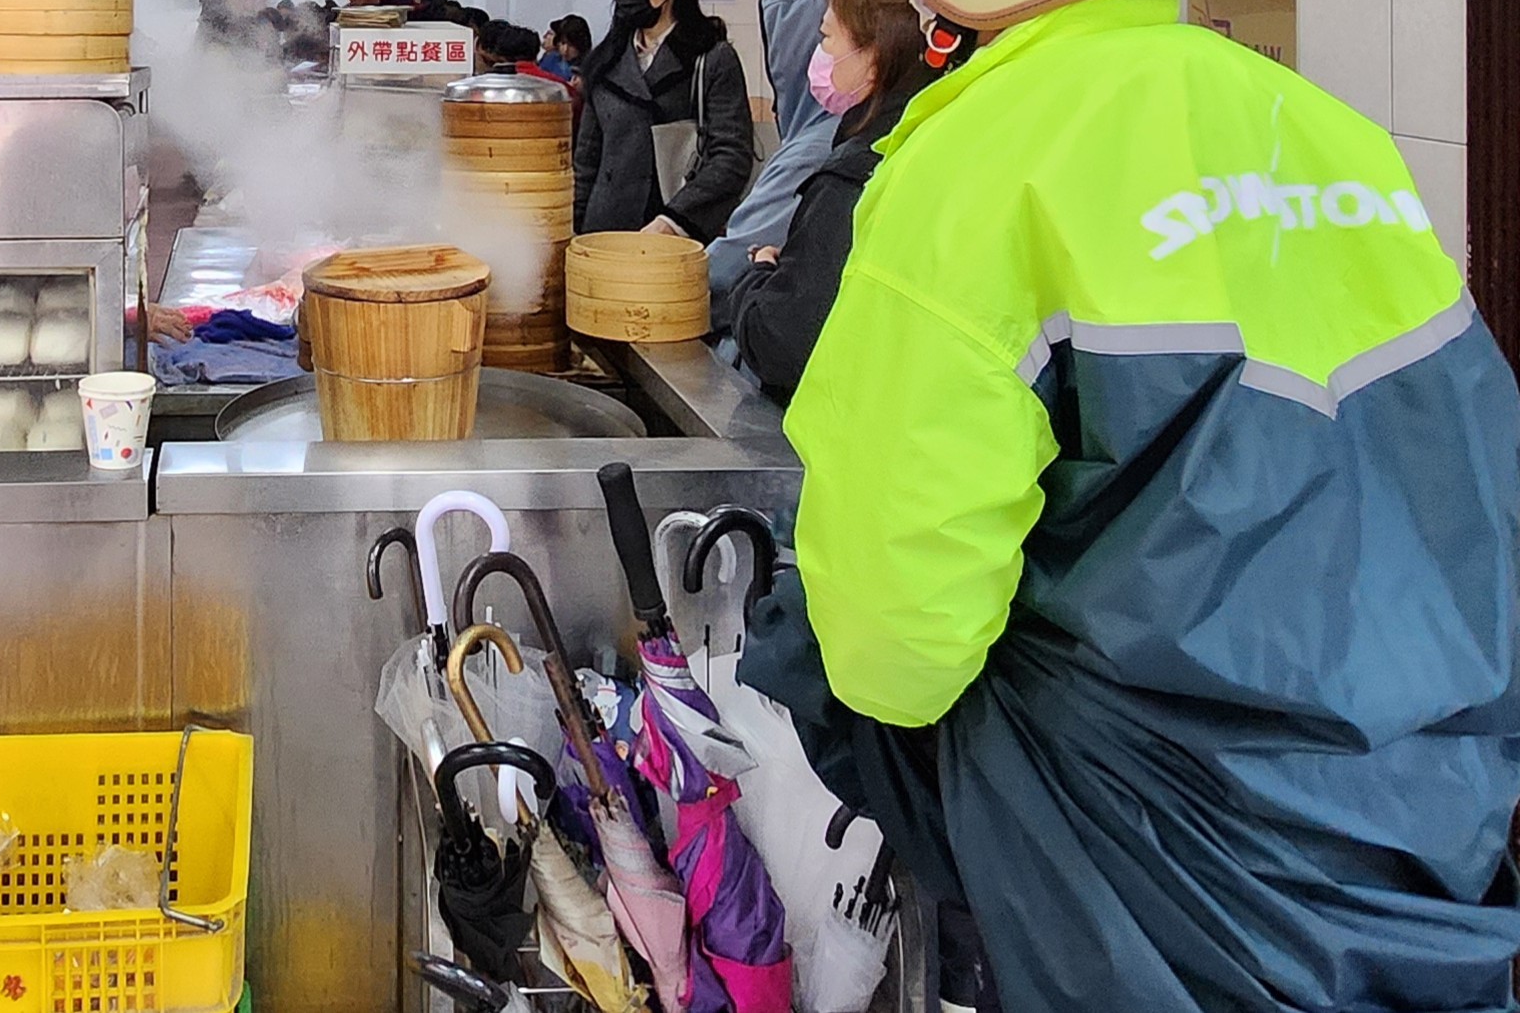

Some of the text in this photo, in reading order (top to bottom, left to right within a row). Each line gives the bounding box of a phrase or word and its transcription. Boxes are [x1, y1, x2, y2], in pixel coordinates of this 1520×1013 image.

[348, 40, 467, 63] 外帶點餐區
